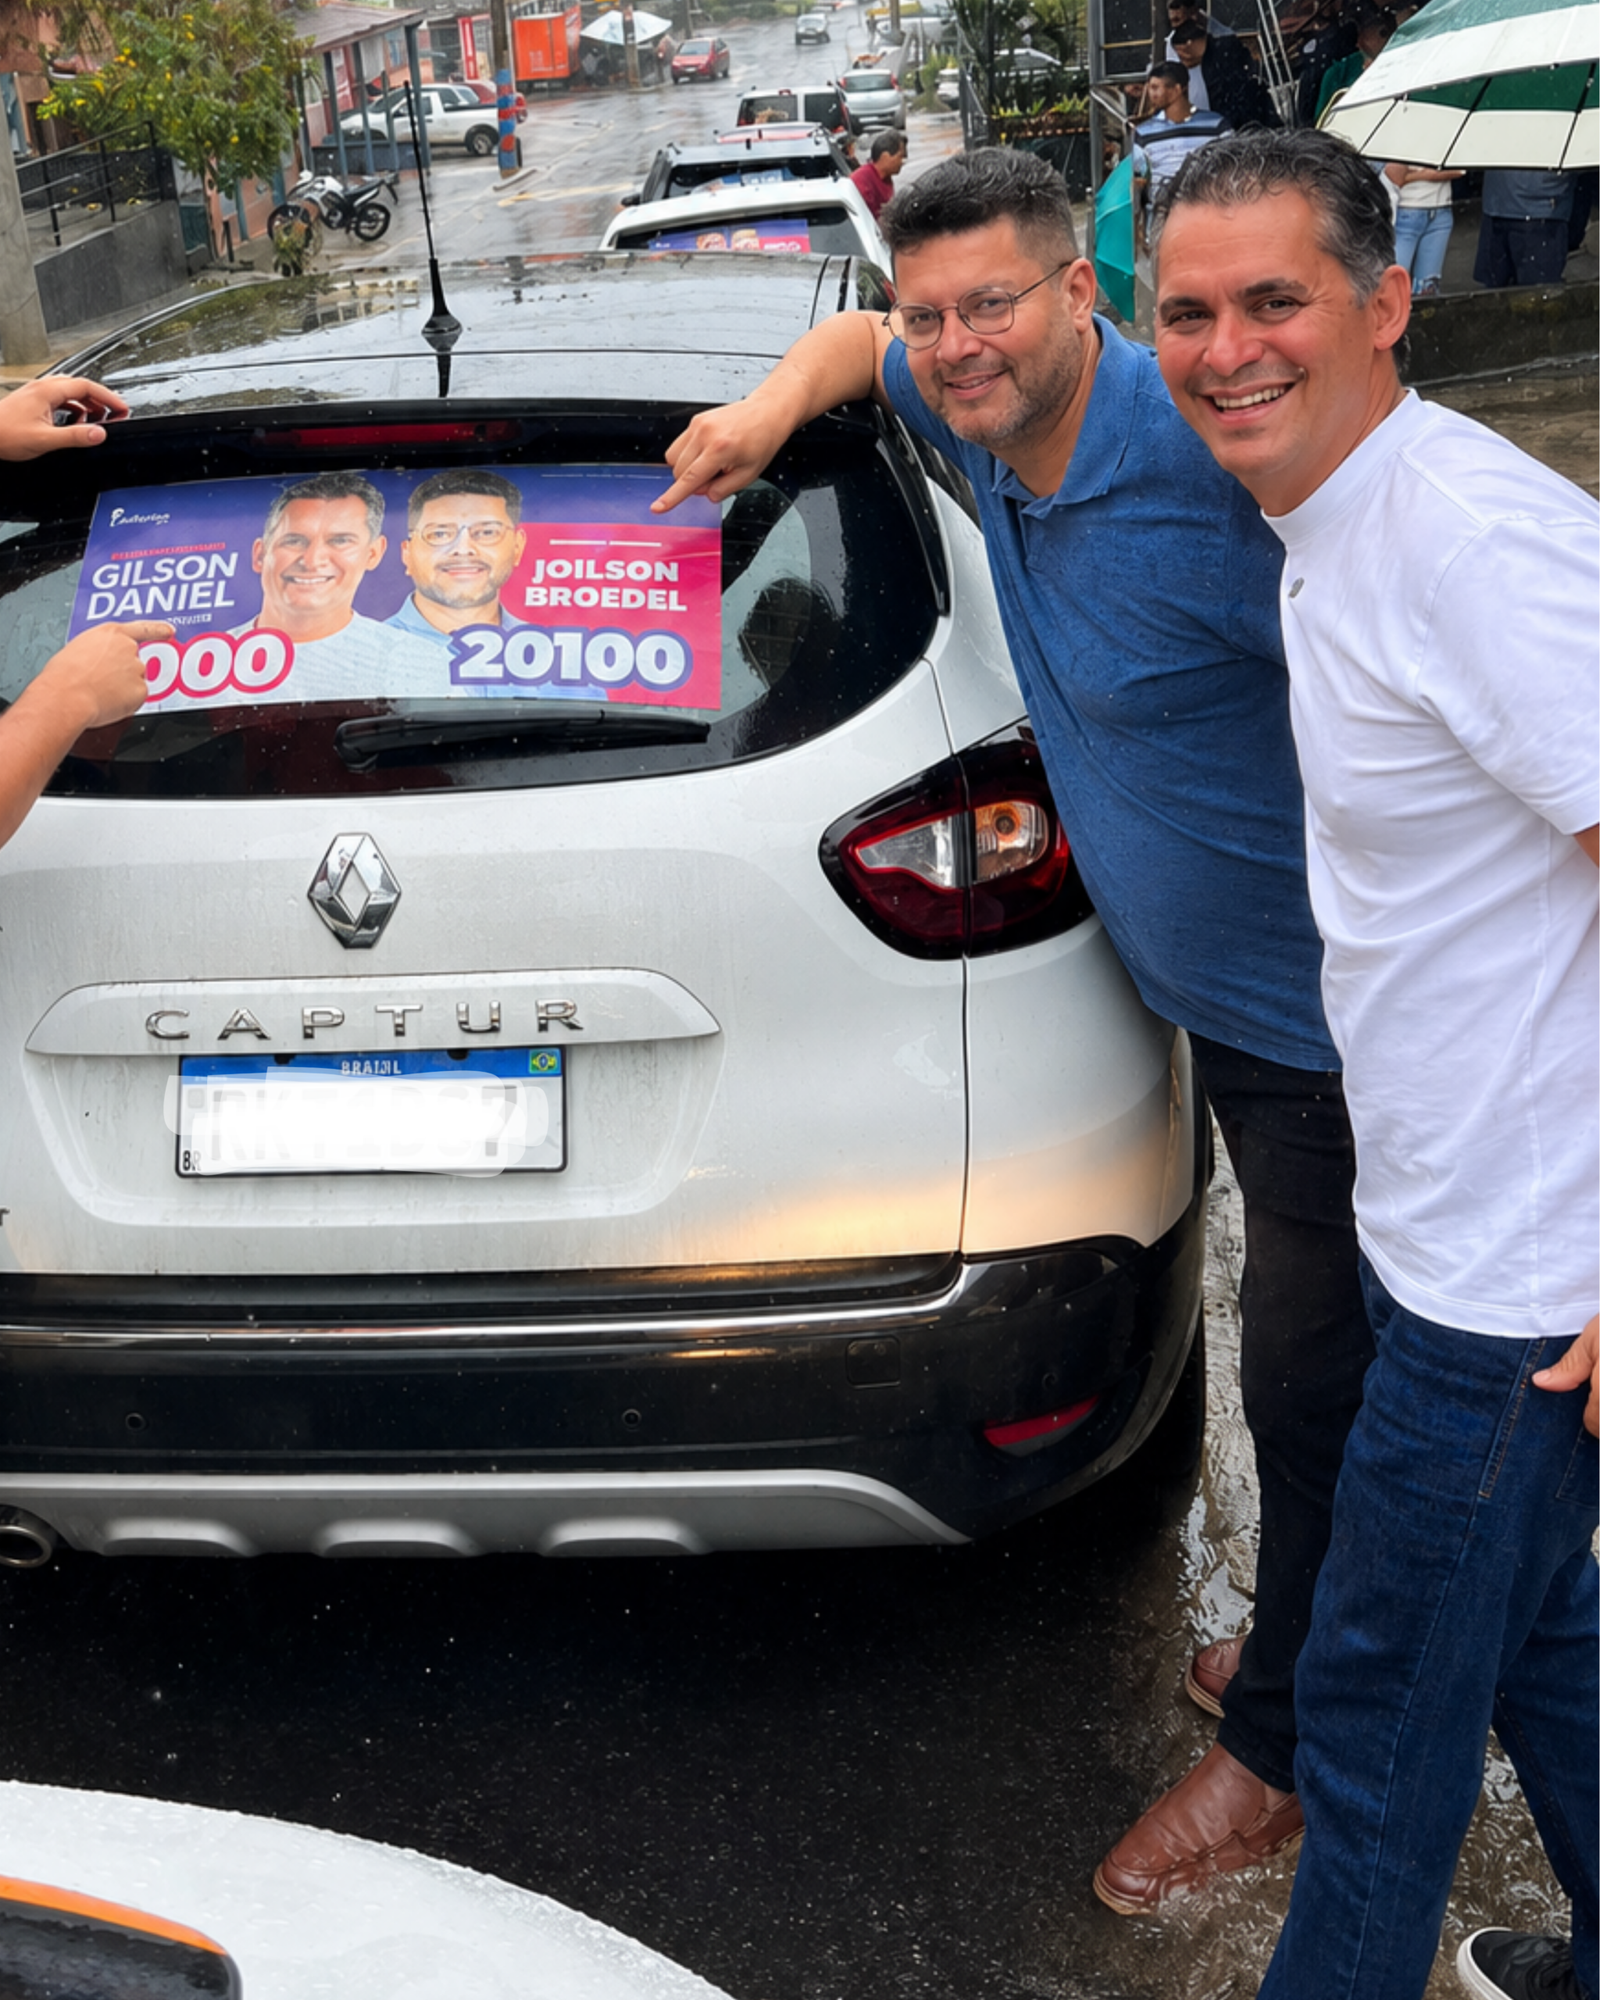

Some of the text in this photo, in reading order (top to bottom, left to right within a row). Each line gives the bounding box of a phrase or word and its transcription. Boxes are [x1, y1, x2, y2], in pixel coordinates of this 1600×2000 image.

[92, 552, 239, 589] GILSON
[532, 559, 679, 584] JOILSON
[86, 580, 236, 620] DANIEL
[525, 586, 687, 611] BROEDEL
[458, 630, 686, 685] 20100
[145, 1000, 584, 1040] CAPTUR
